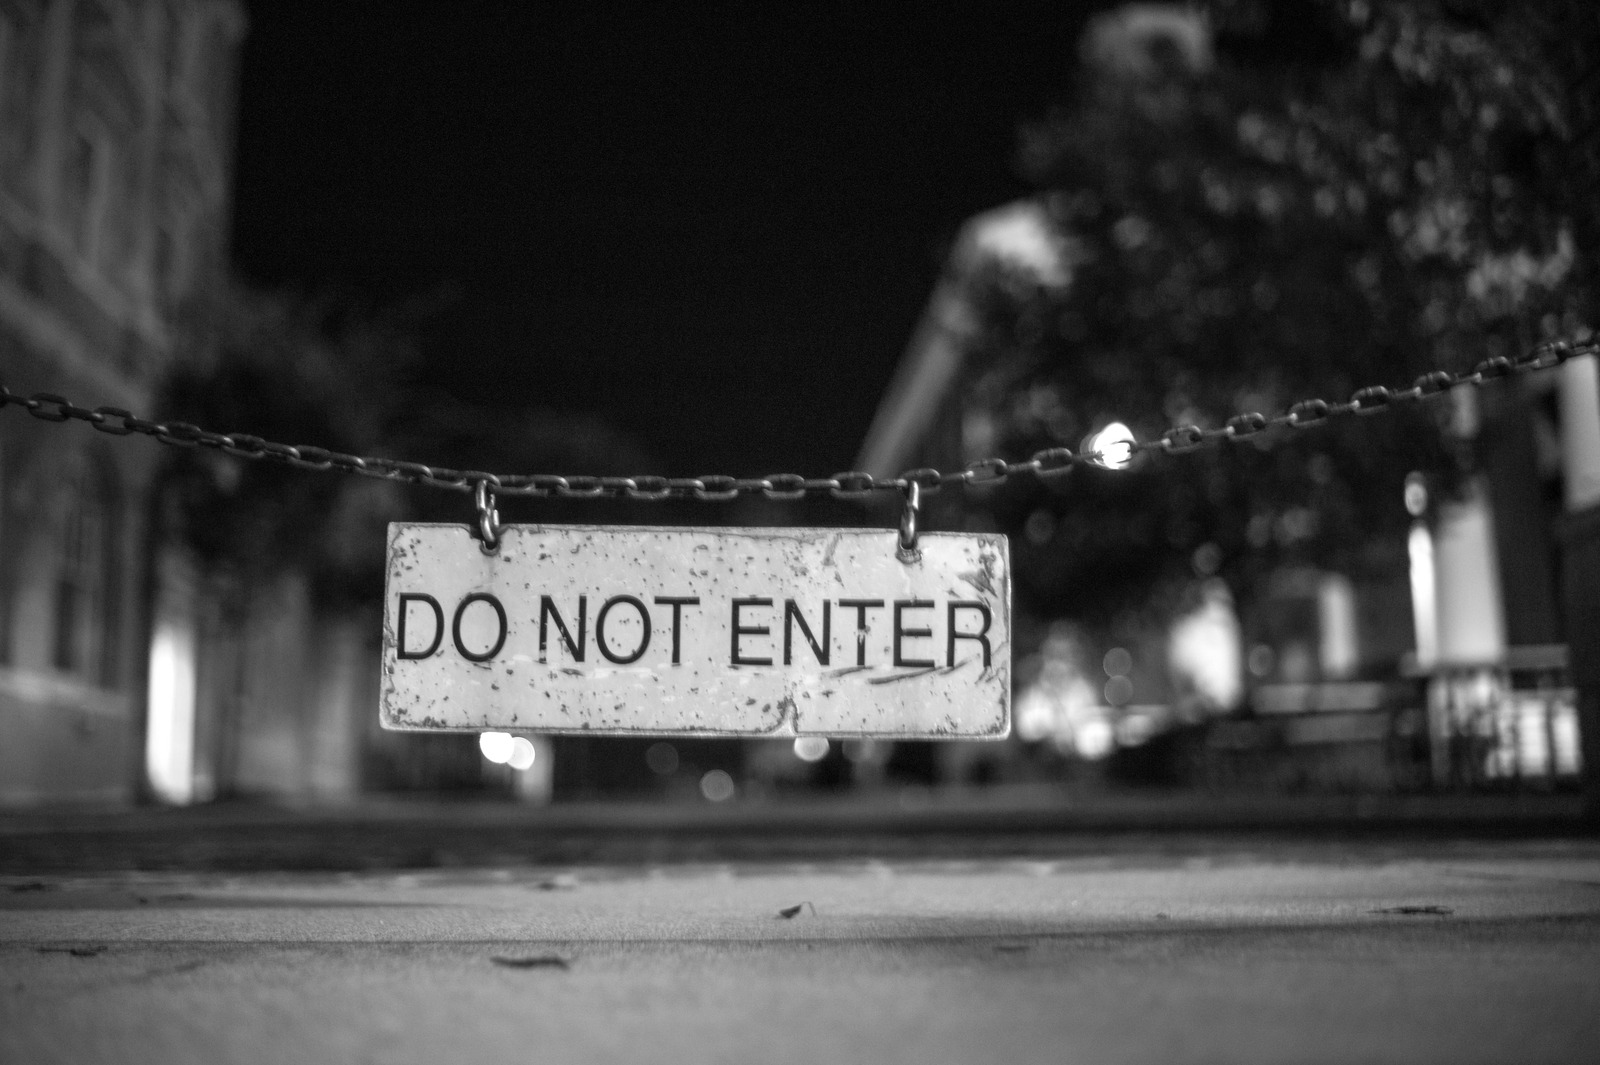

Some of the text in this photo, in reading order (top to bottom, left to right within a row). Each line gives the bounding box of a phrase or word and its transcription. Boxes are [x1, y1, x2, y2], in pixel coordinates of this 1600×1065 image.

[397, 592, 992, 667] DO NOT ENTER
